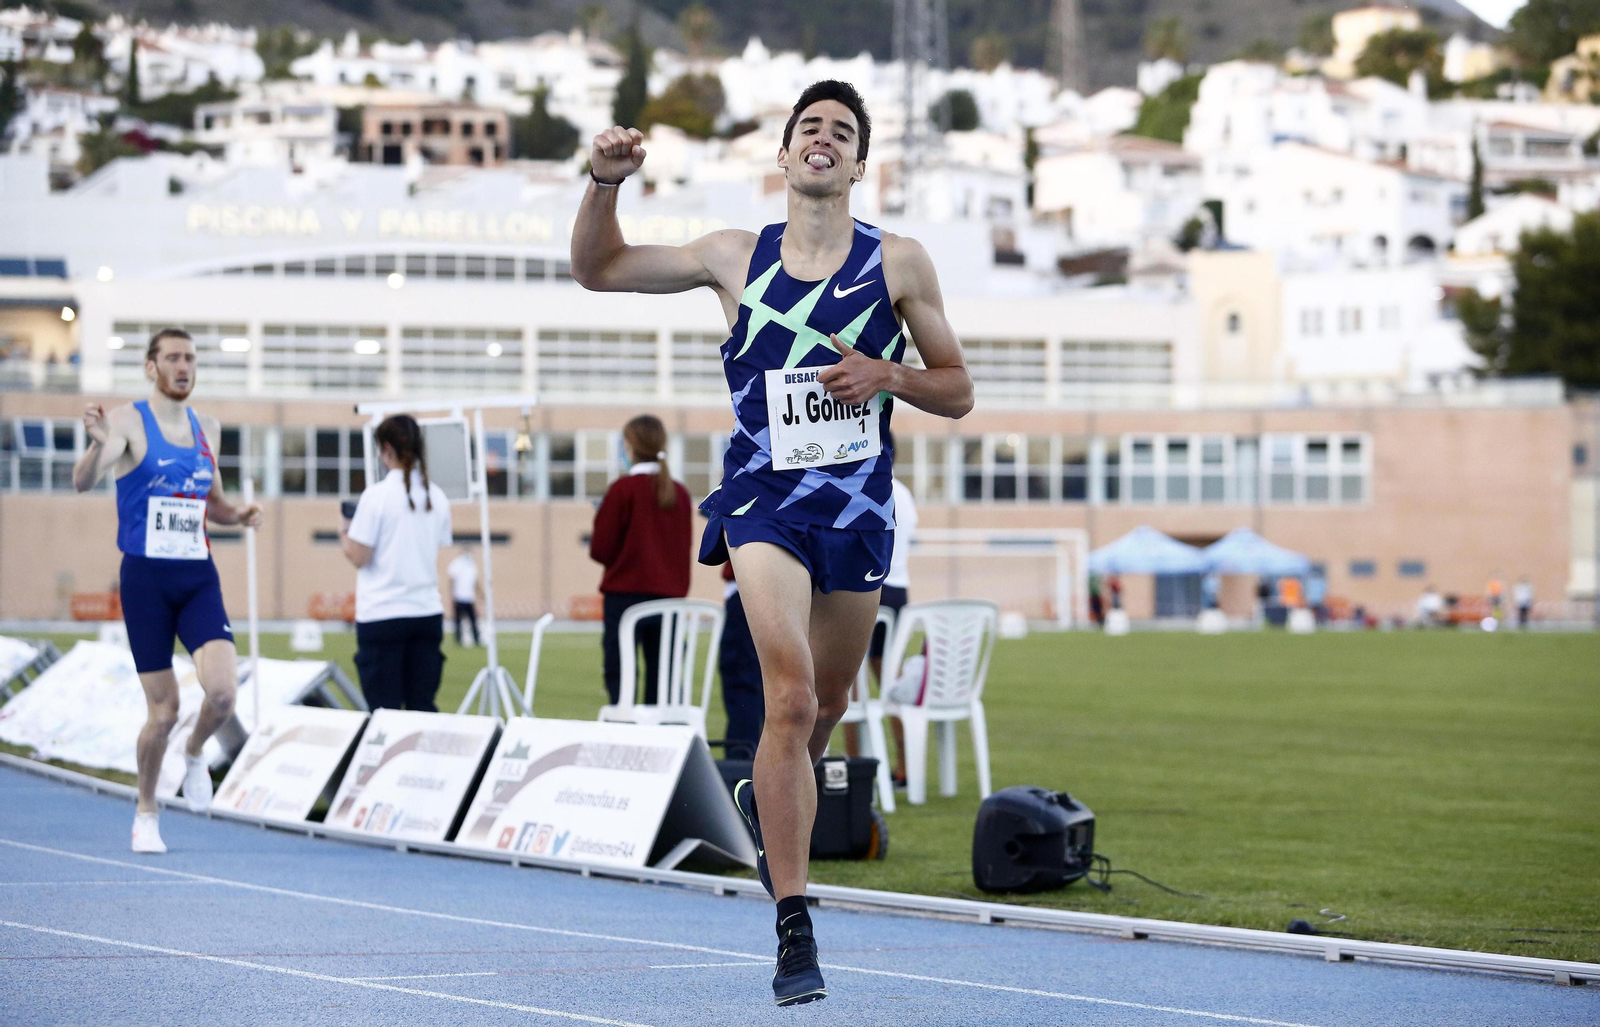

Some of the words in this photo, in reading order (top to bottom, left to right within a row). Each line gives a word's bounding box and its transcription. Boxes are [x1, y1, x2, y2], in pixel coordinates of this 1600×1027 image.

[186, 204, 321, 237] PISCINA
[341, 207, 363, 236] Y
[782, 394, 800, 425] J.
[806, 391, 871, 423] Gómez
[858, 419, 866, 433] 1
[155, 512, 165, 531] B.
